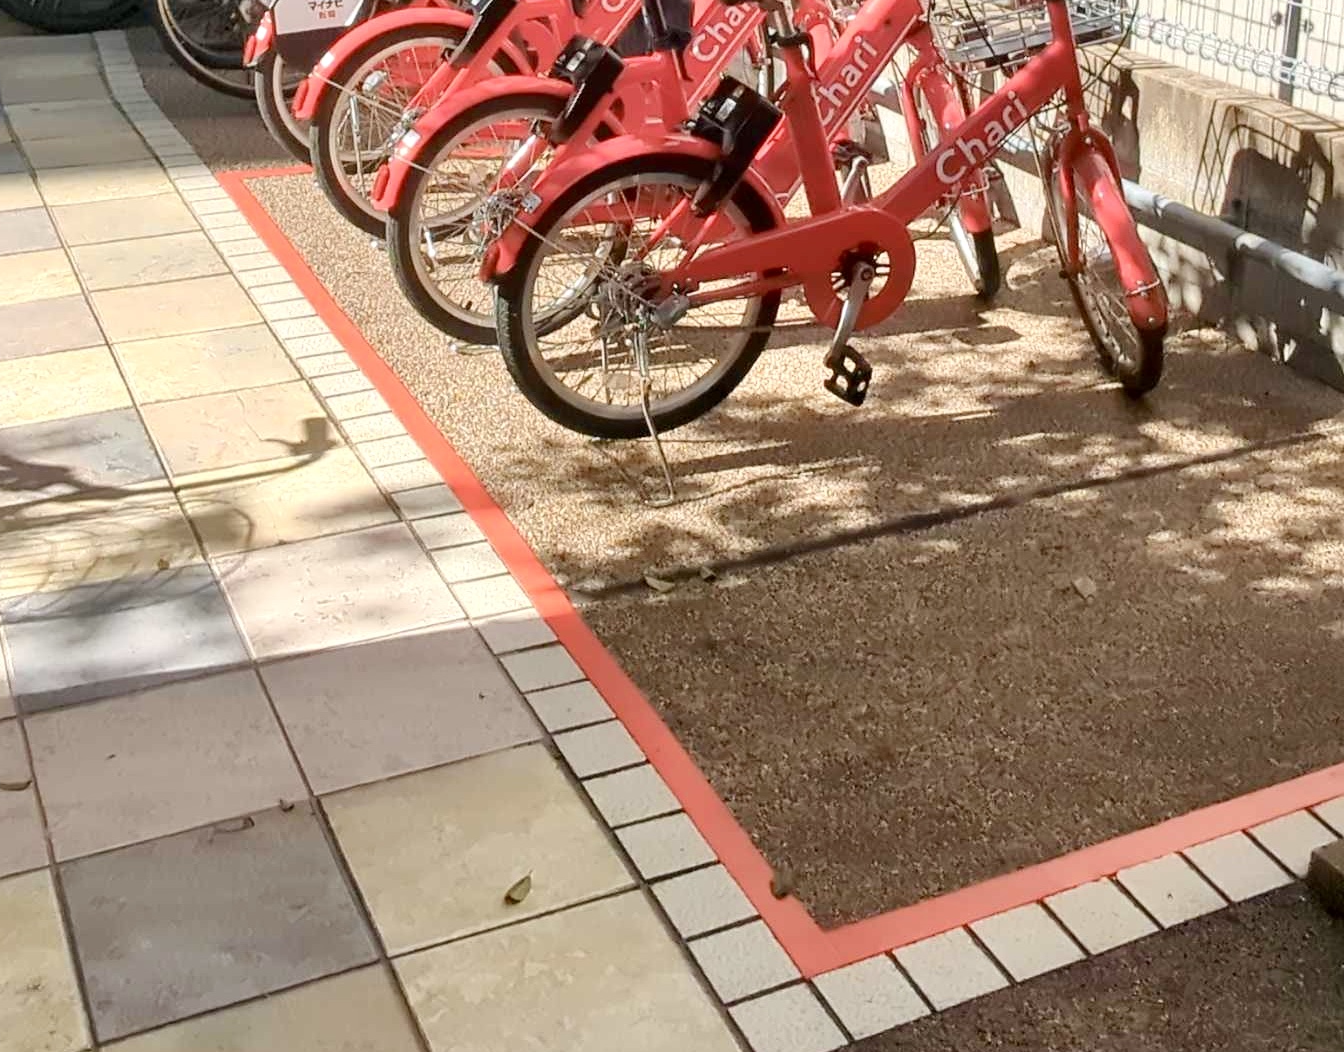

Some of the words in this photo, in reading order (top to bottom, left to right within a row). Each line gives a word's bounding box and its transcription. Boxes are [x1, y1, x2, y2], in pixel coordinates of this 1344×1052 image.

[308, 0, 343, 11] マイナビ
[935, 90, 1029, 185] Chari
